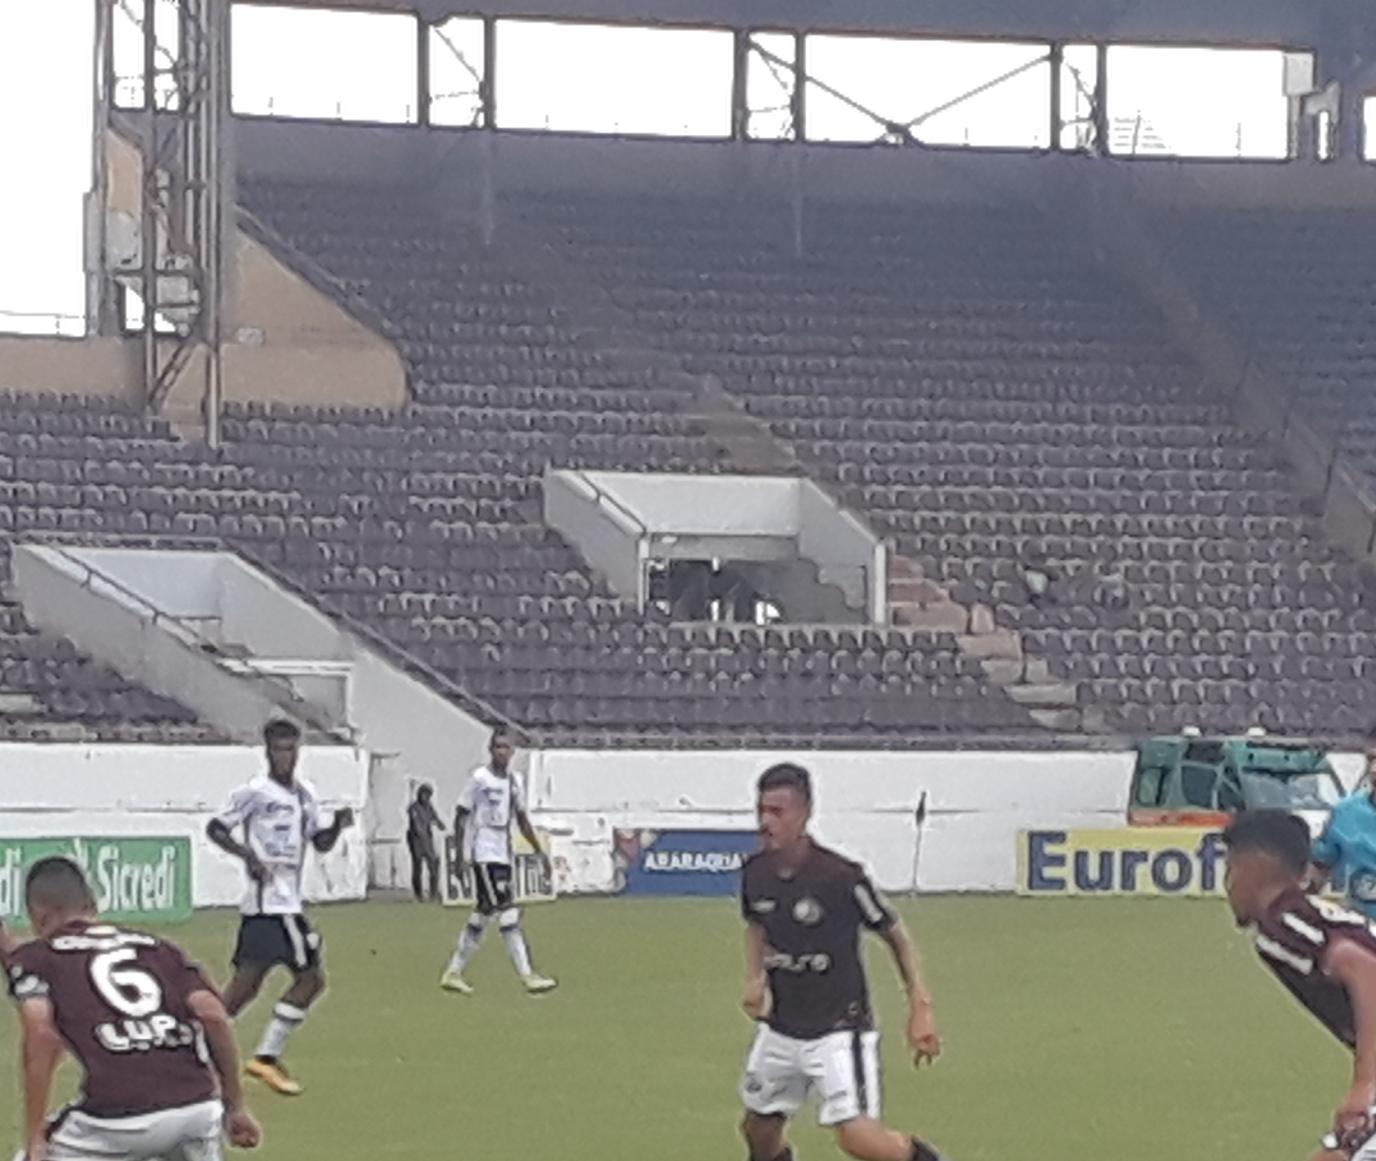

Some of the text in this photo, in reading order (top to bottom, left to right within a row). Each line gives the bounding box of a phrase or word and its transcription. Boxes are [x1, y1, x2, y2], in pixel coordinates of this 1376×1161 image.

[97, 846, 176, 912] Sicredi
[645, 851, 747, 873] ARARAQUA
[1028, 831, 1229, 892] Eurof
[90, 948, 161, 1017] 6
